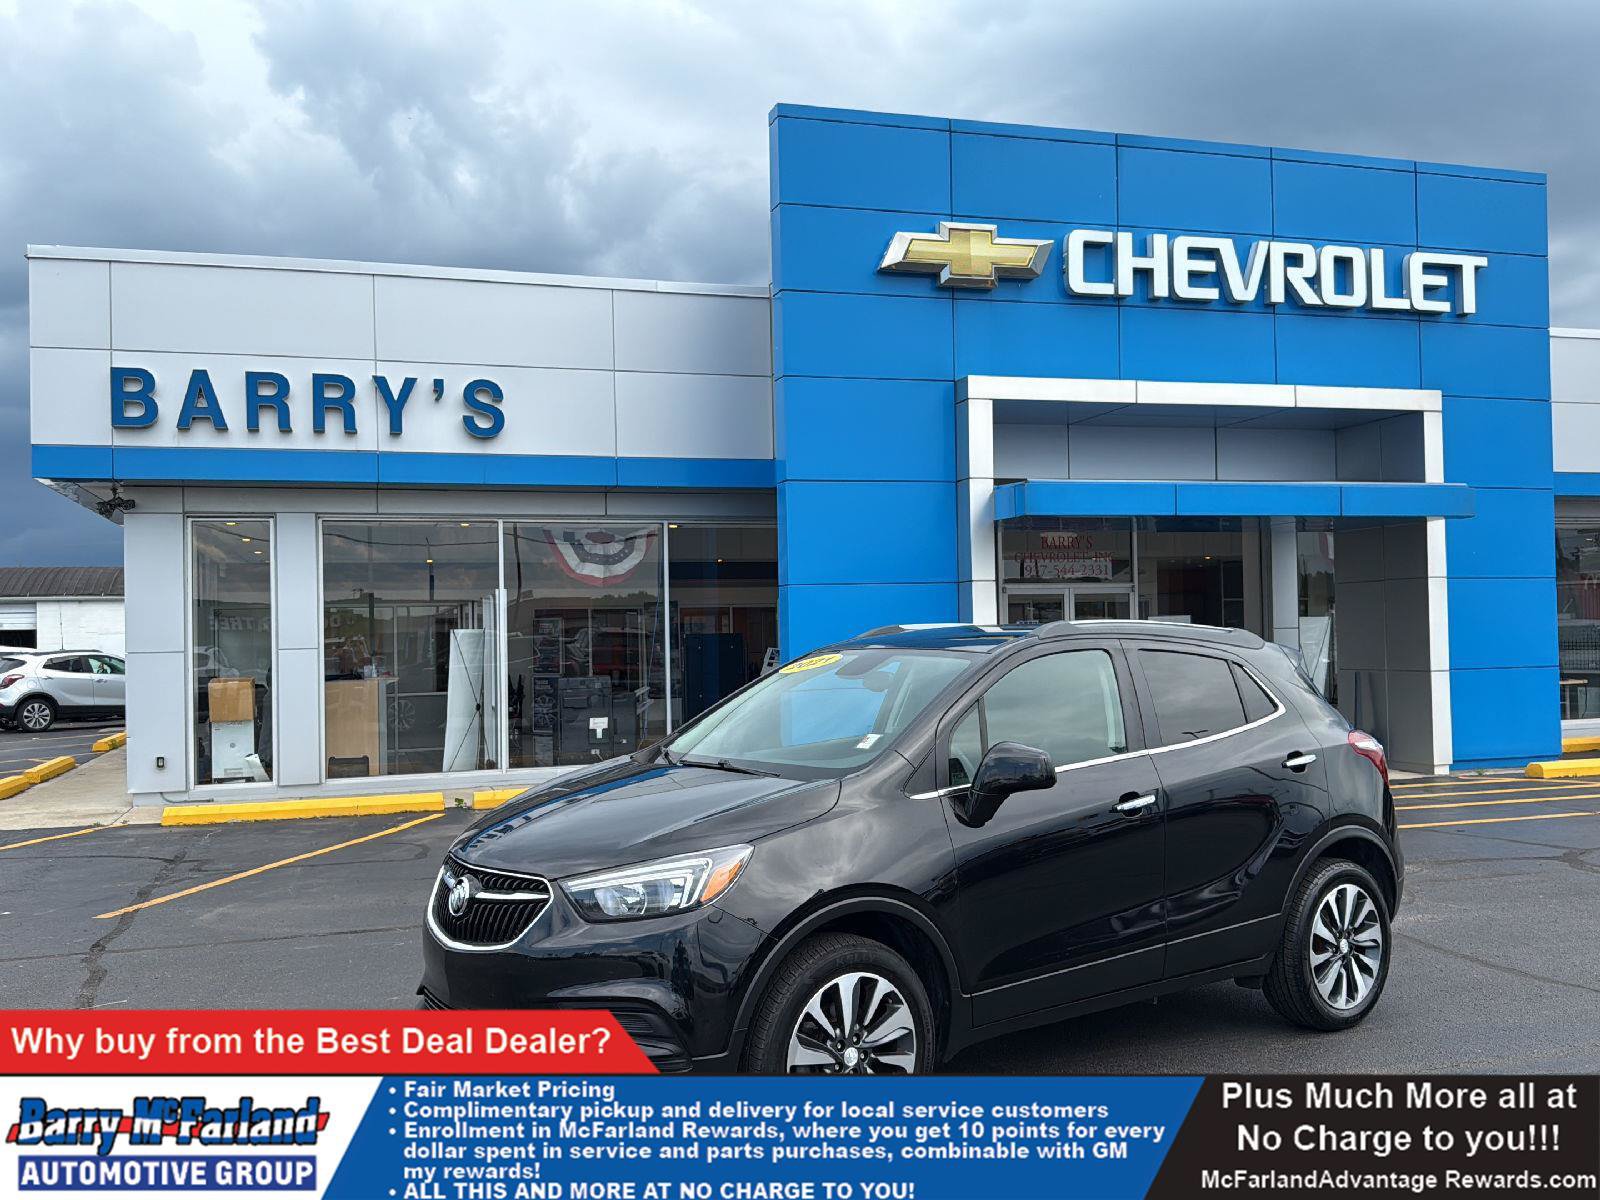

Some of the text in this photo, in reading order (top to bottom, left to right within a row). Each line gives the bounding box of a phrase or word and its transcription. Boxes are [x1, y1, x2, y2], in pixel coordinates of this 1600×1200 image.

[1063, 229, 1488, 315] CHEVROLET
[110, 366, 506, 439] BARRY'S
[1014, 551, 1088, 563] CHEVROLET
[1041, 536, 1094, 550] BARRY'S
